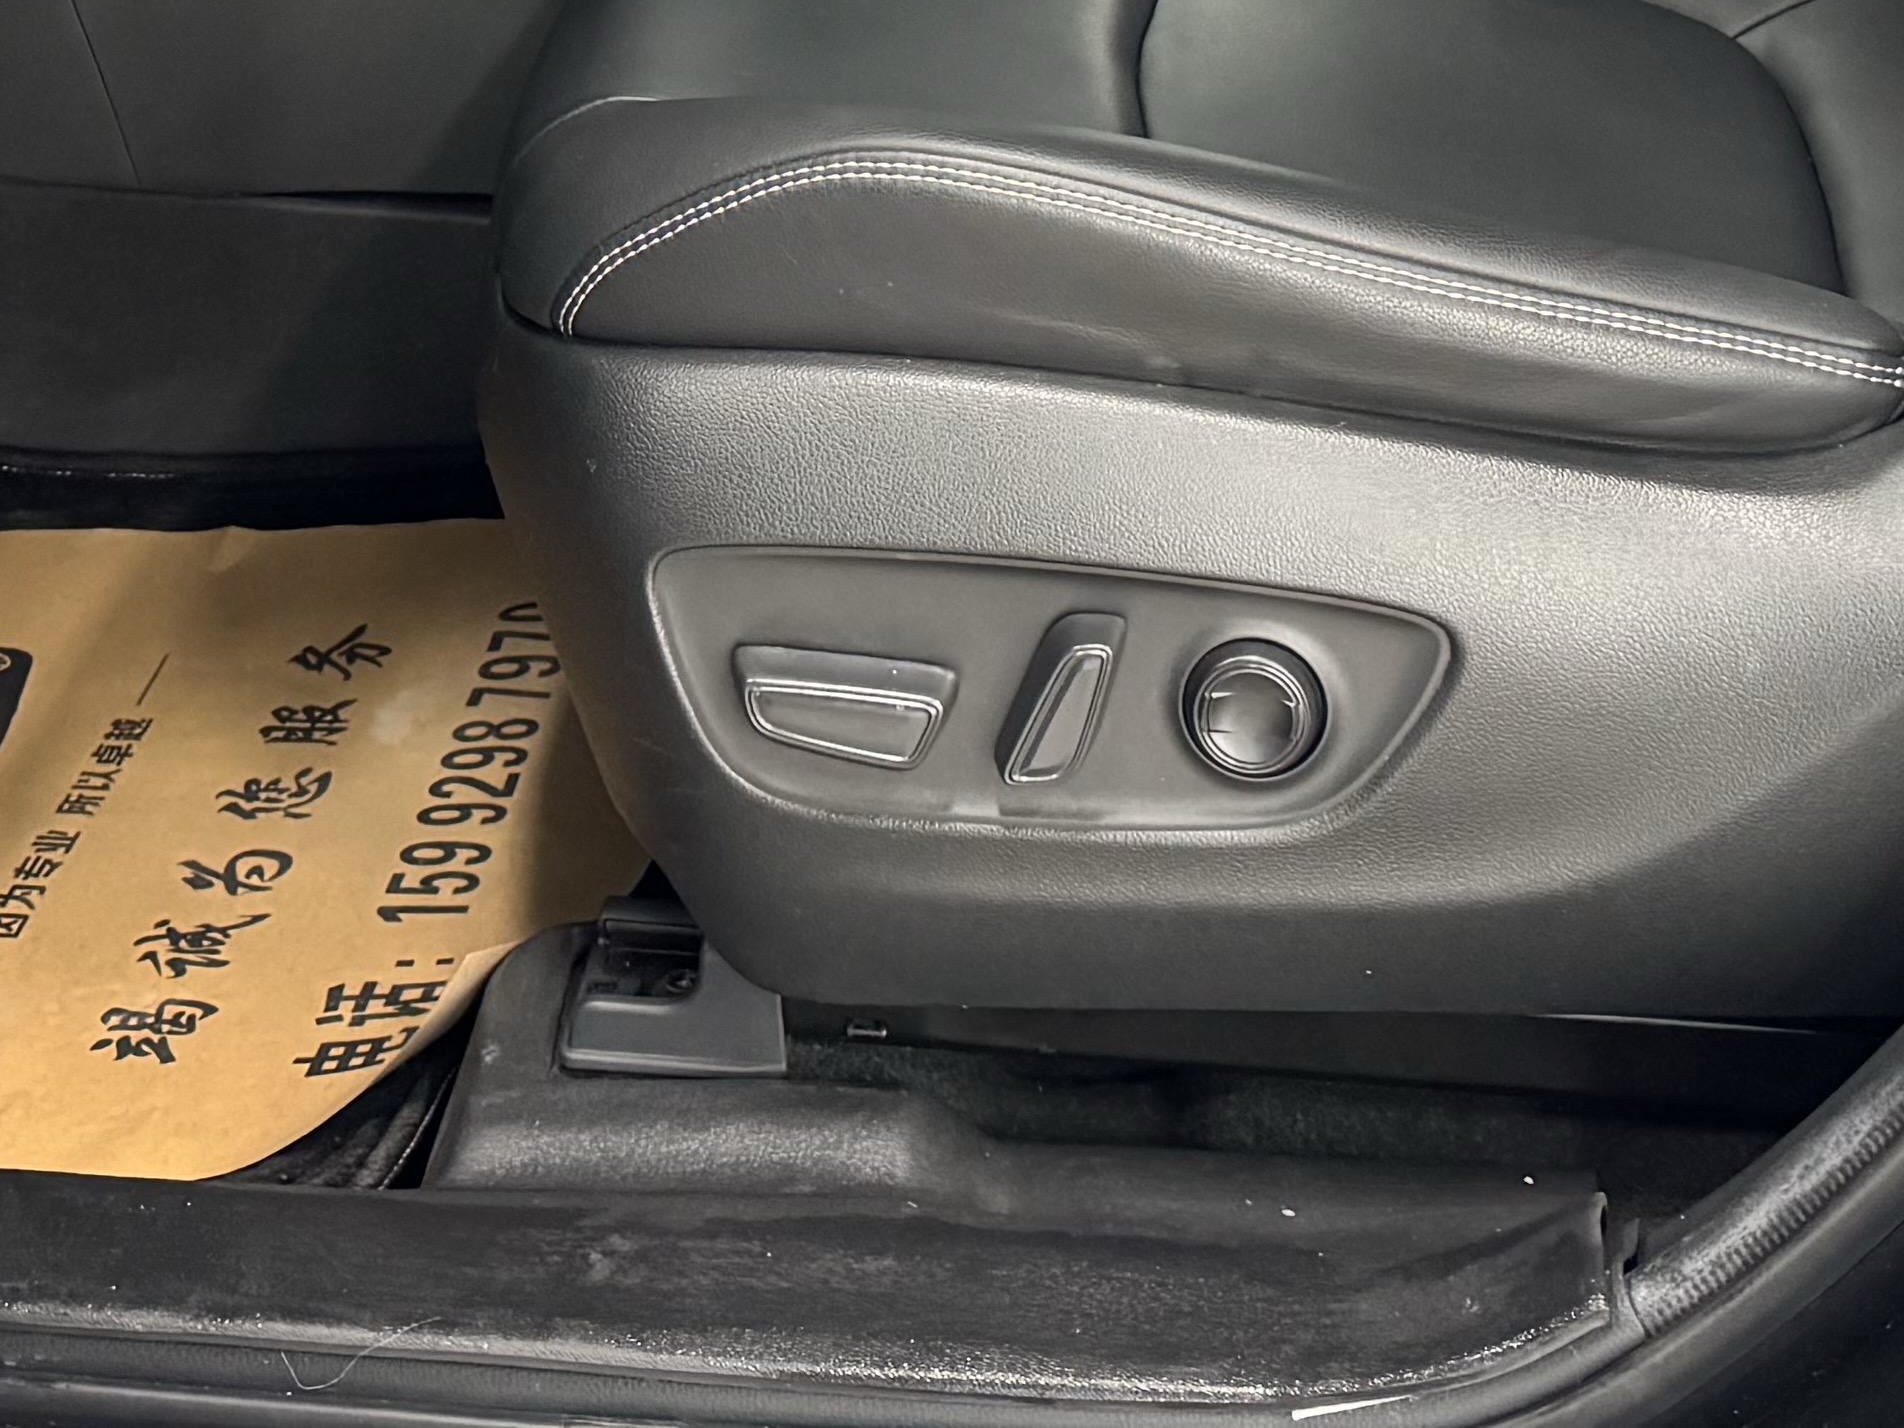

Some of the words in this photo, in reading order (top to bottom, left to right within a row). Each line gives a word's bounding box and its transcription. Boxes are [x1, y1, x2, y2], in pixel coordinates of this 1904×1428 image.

[55, 717, 154, 817] 所以卓越
[416, 718, 540, 826] 9298
[89, 622, 392, 1065] 竭诚为您服务
[376, 840, 493, 923] 159
